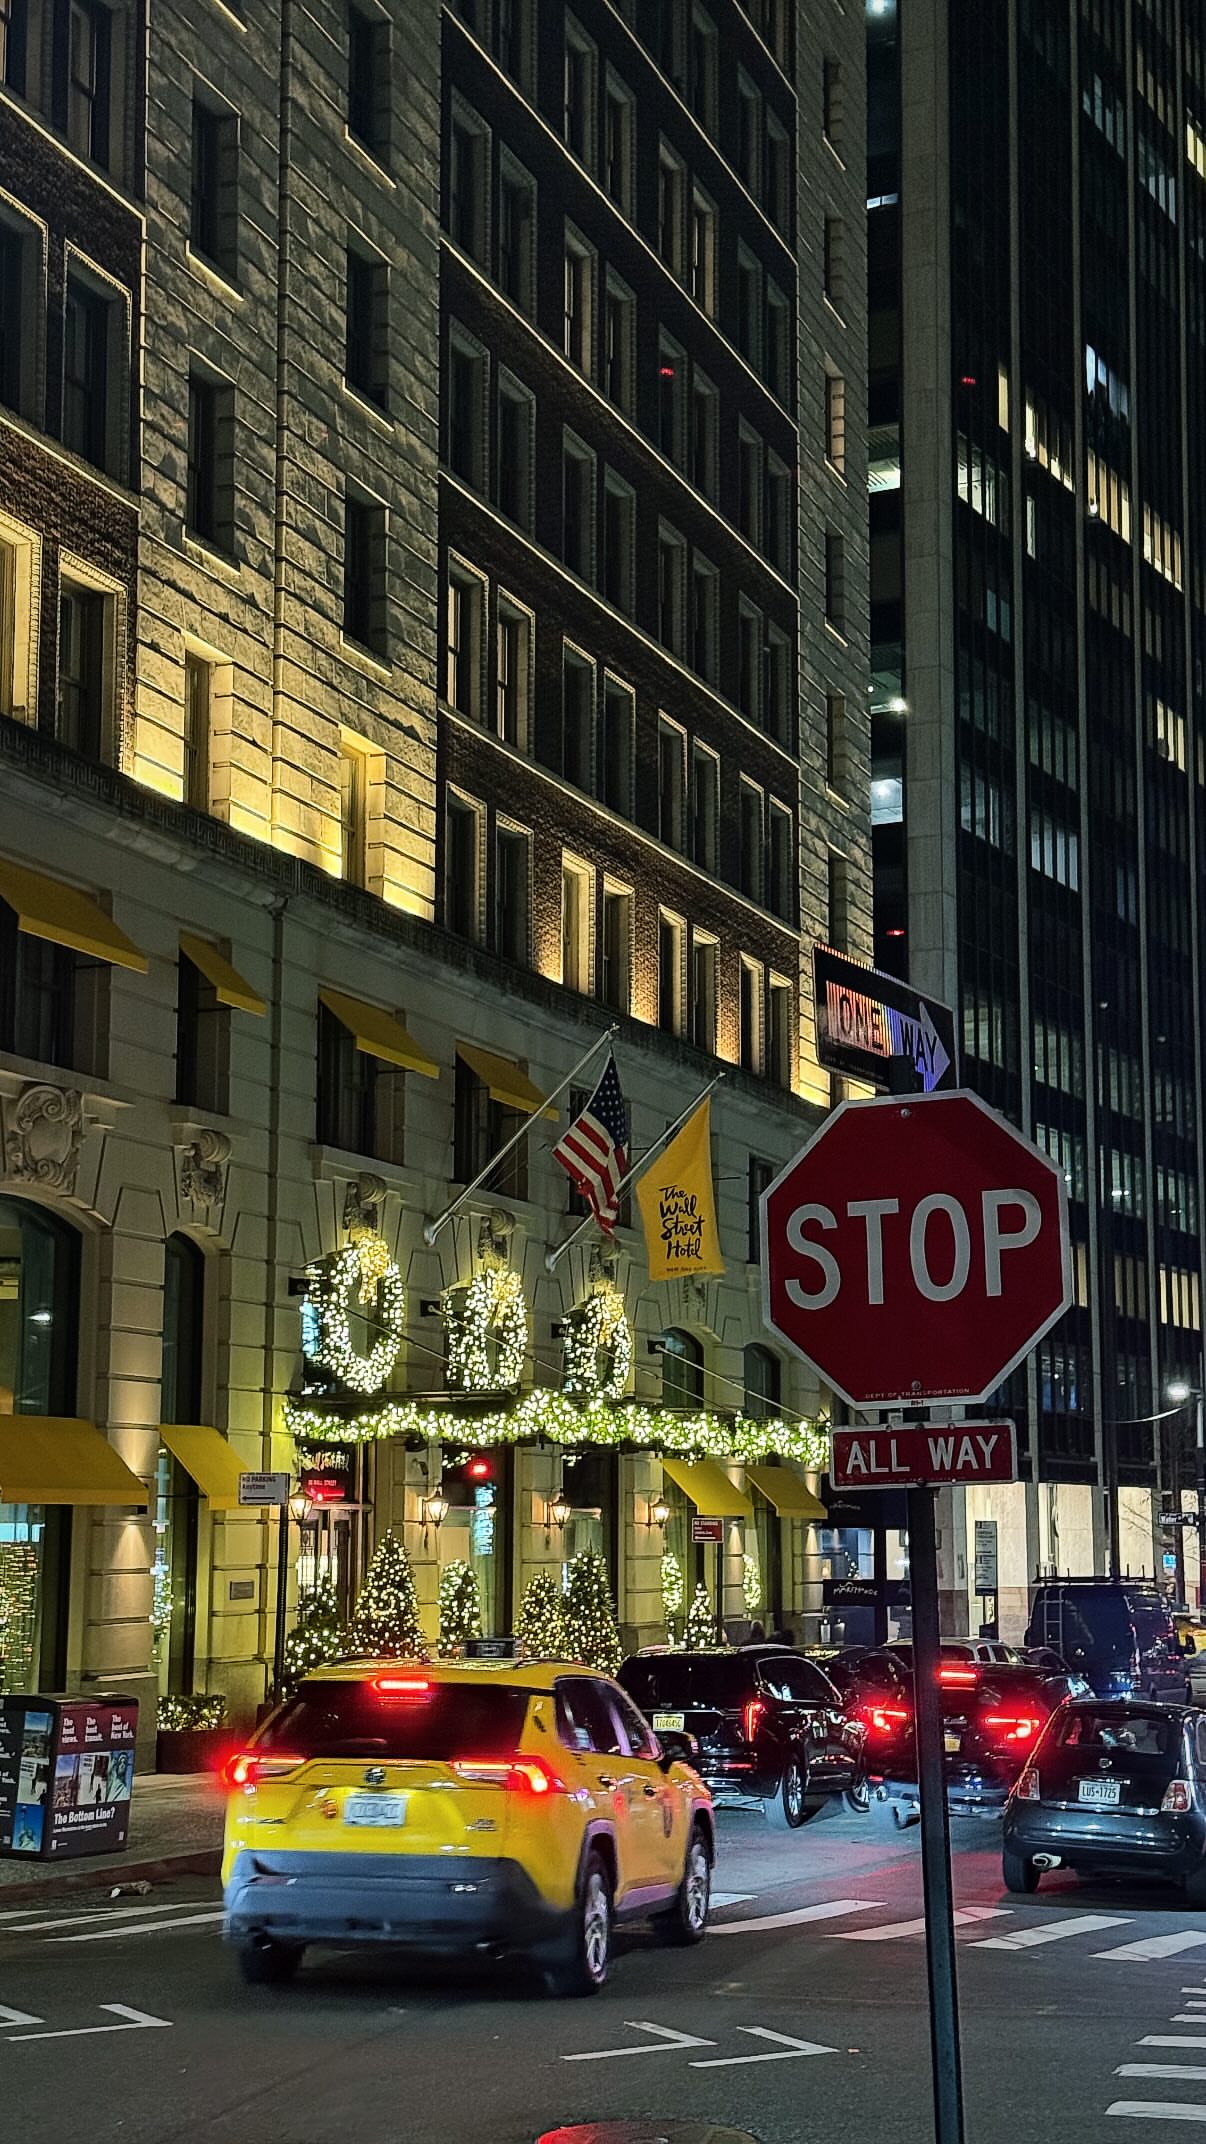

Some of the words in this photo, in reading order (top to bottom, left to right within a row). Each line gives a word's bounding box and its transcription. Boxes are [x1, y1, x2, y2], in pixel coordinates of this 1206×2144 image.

[839, 993, 883, 1050] ONE
[900, 1018, 937, 1073] WAY
[659, 1185, 687, 1201] The
[660, 1194, 697, 1219] Wall
[661, 1214, 705, 1240] Street
[666, 1236, 703, 1260] Hotel
[785, 1188, 1042, 1311] STOP
[901, 1387, 970, 1397] TRANSPORTATION
[846, 1439, 910, 1474] ALL
[928, 1435, 998, 1471] WAY
[54, 1812, 67, 1825] The
[68, 1810, 95, 1823] Bottom
[95, 1806, 116, 1820] Line?
